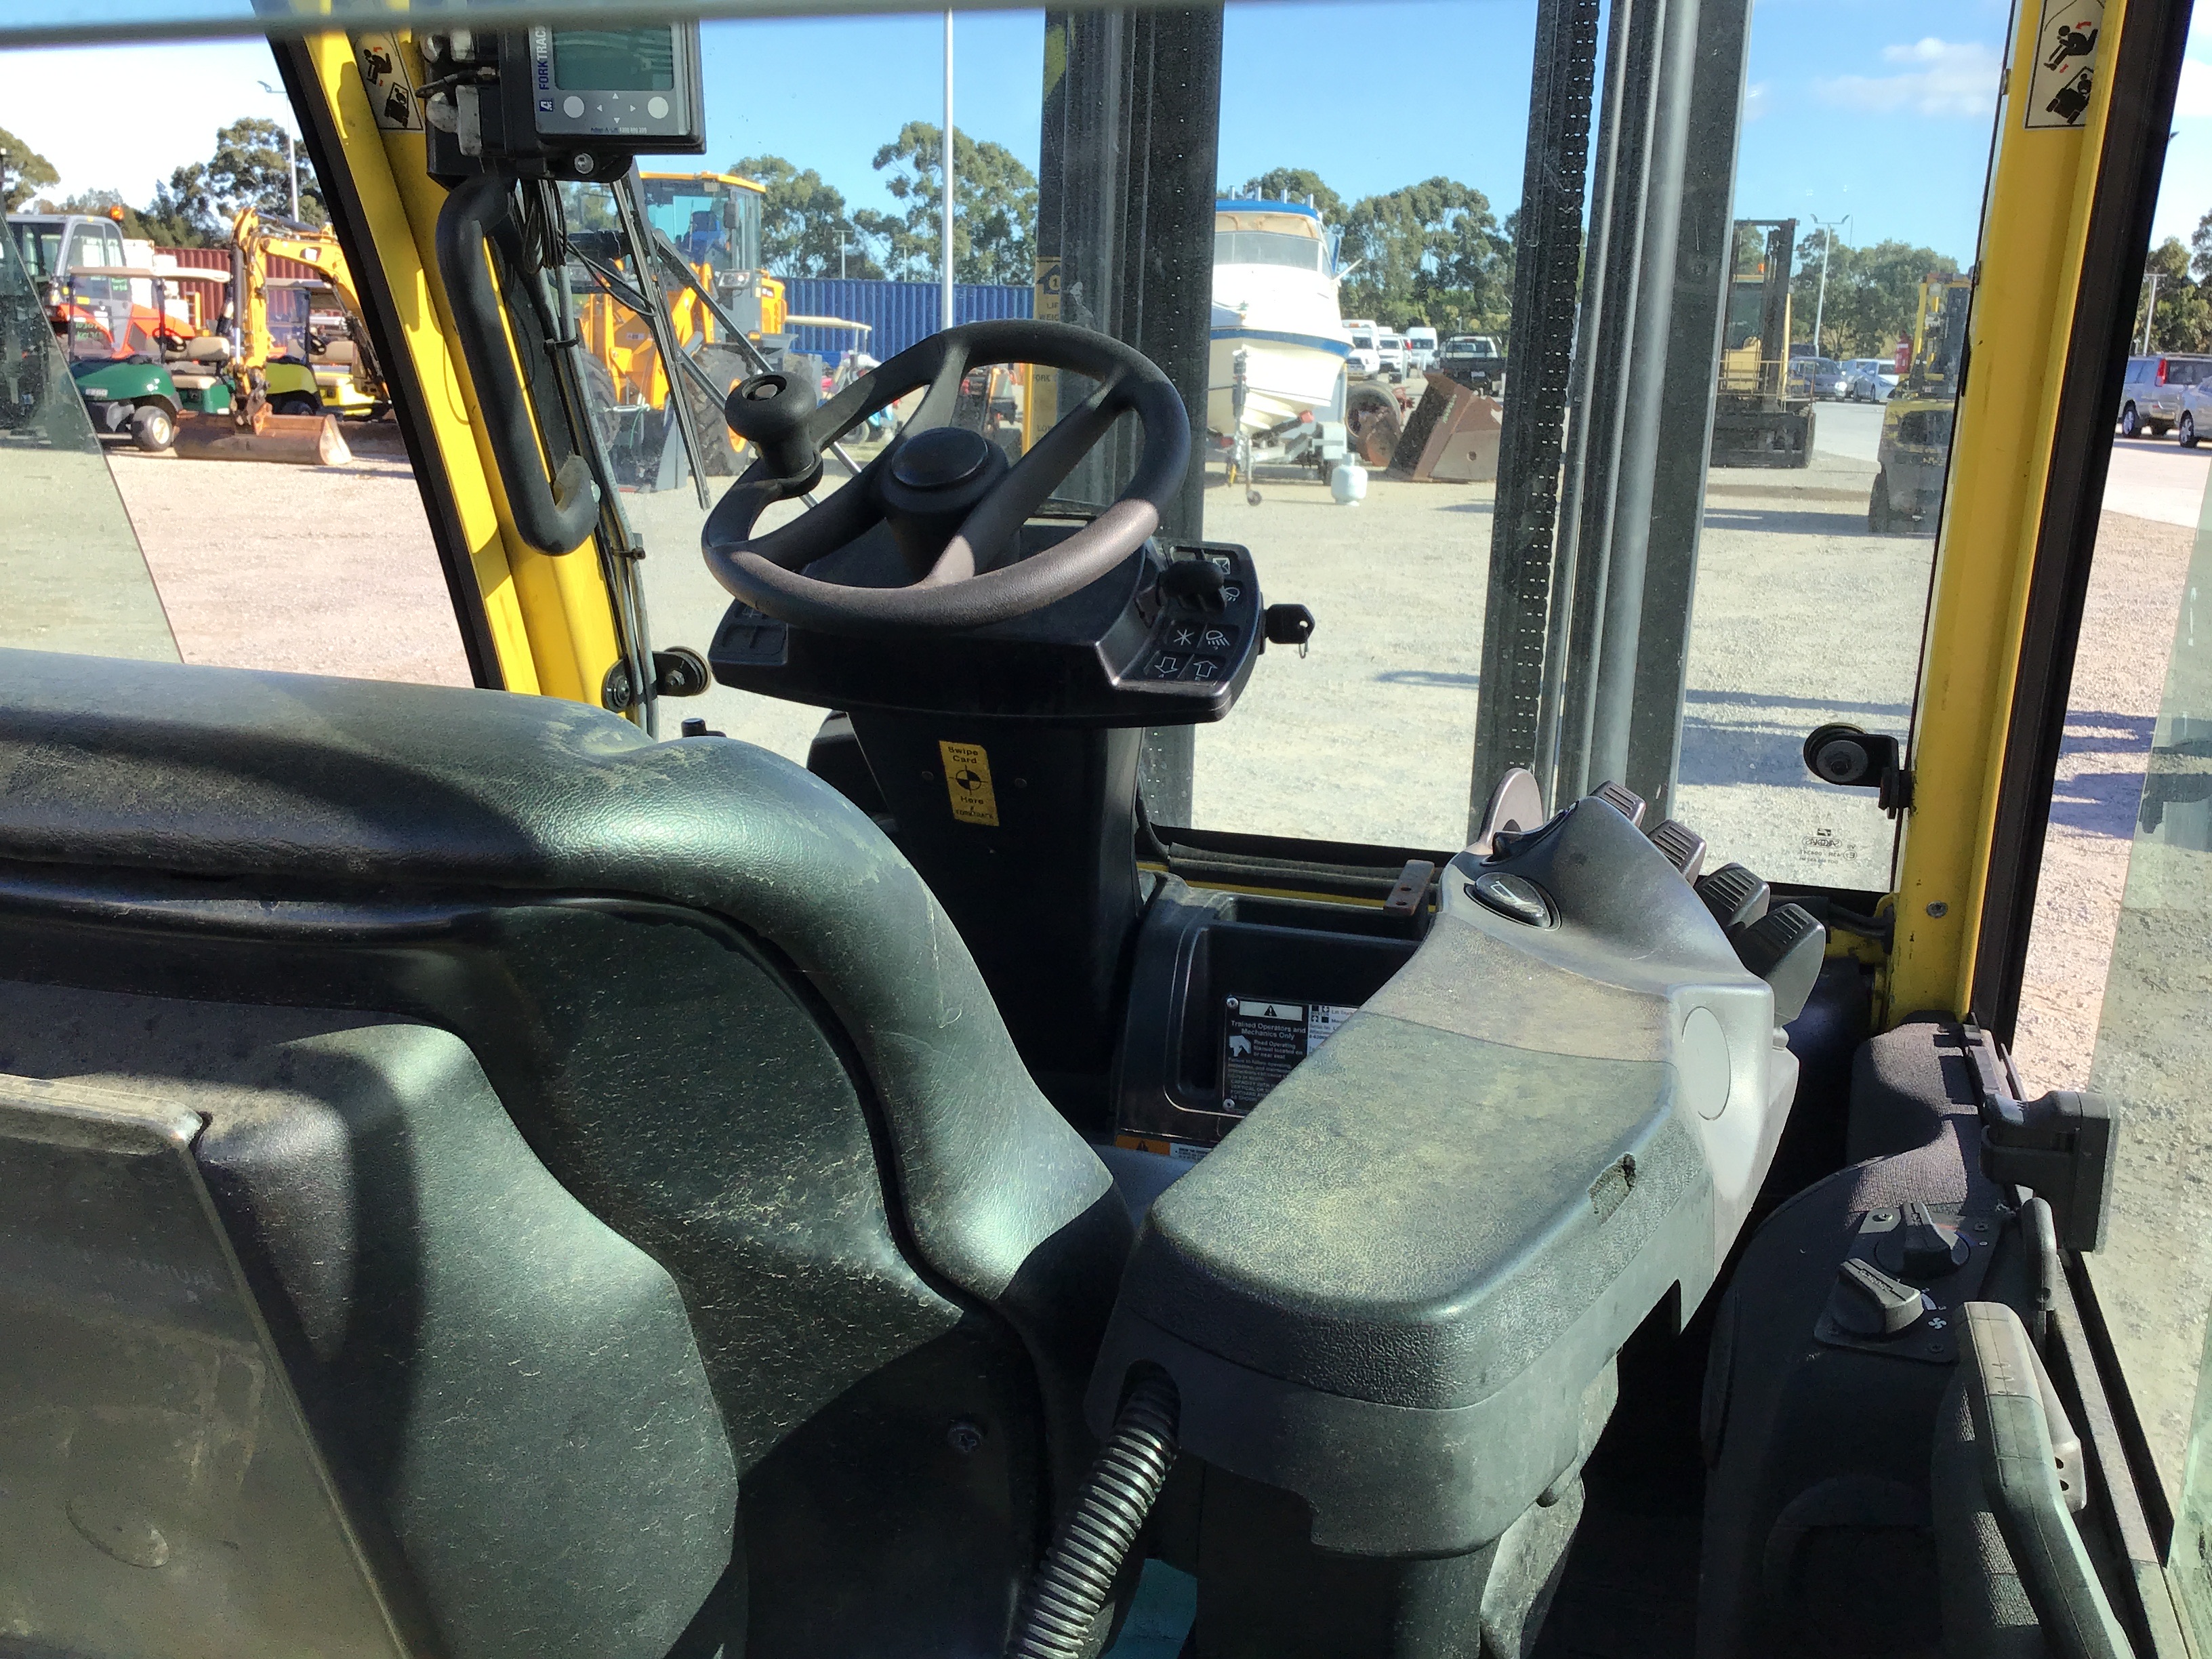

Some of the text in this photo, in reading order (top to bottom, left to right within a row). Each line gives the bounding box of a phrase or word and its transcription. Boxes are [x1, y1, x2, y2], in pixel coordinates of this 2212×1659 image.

[948, 746, 979, 756] Swipe
[953, 755, 977, 764] Card
[960, 796, 984, 804] Here
[1231, 1020, 1256, 1029] Trained
[1258, 1023, 1291, 1032] Operators
[1242, 1028, 1294, 1040] Mechanics Only
